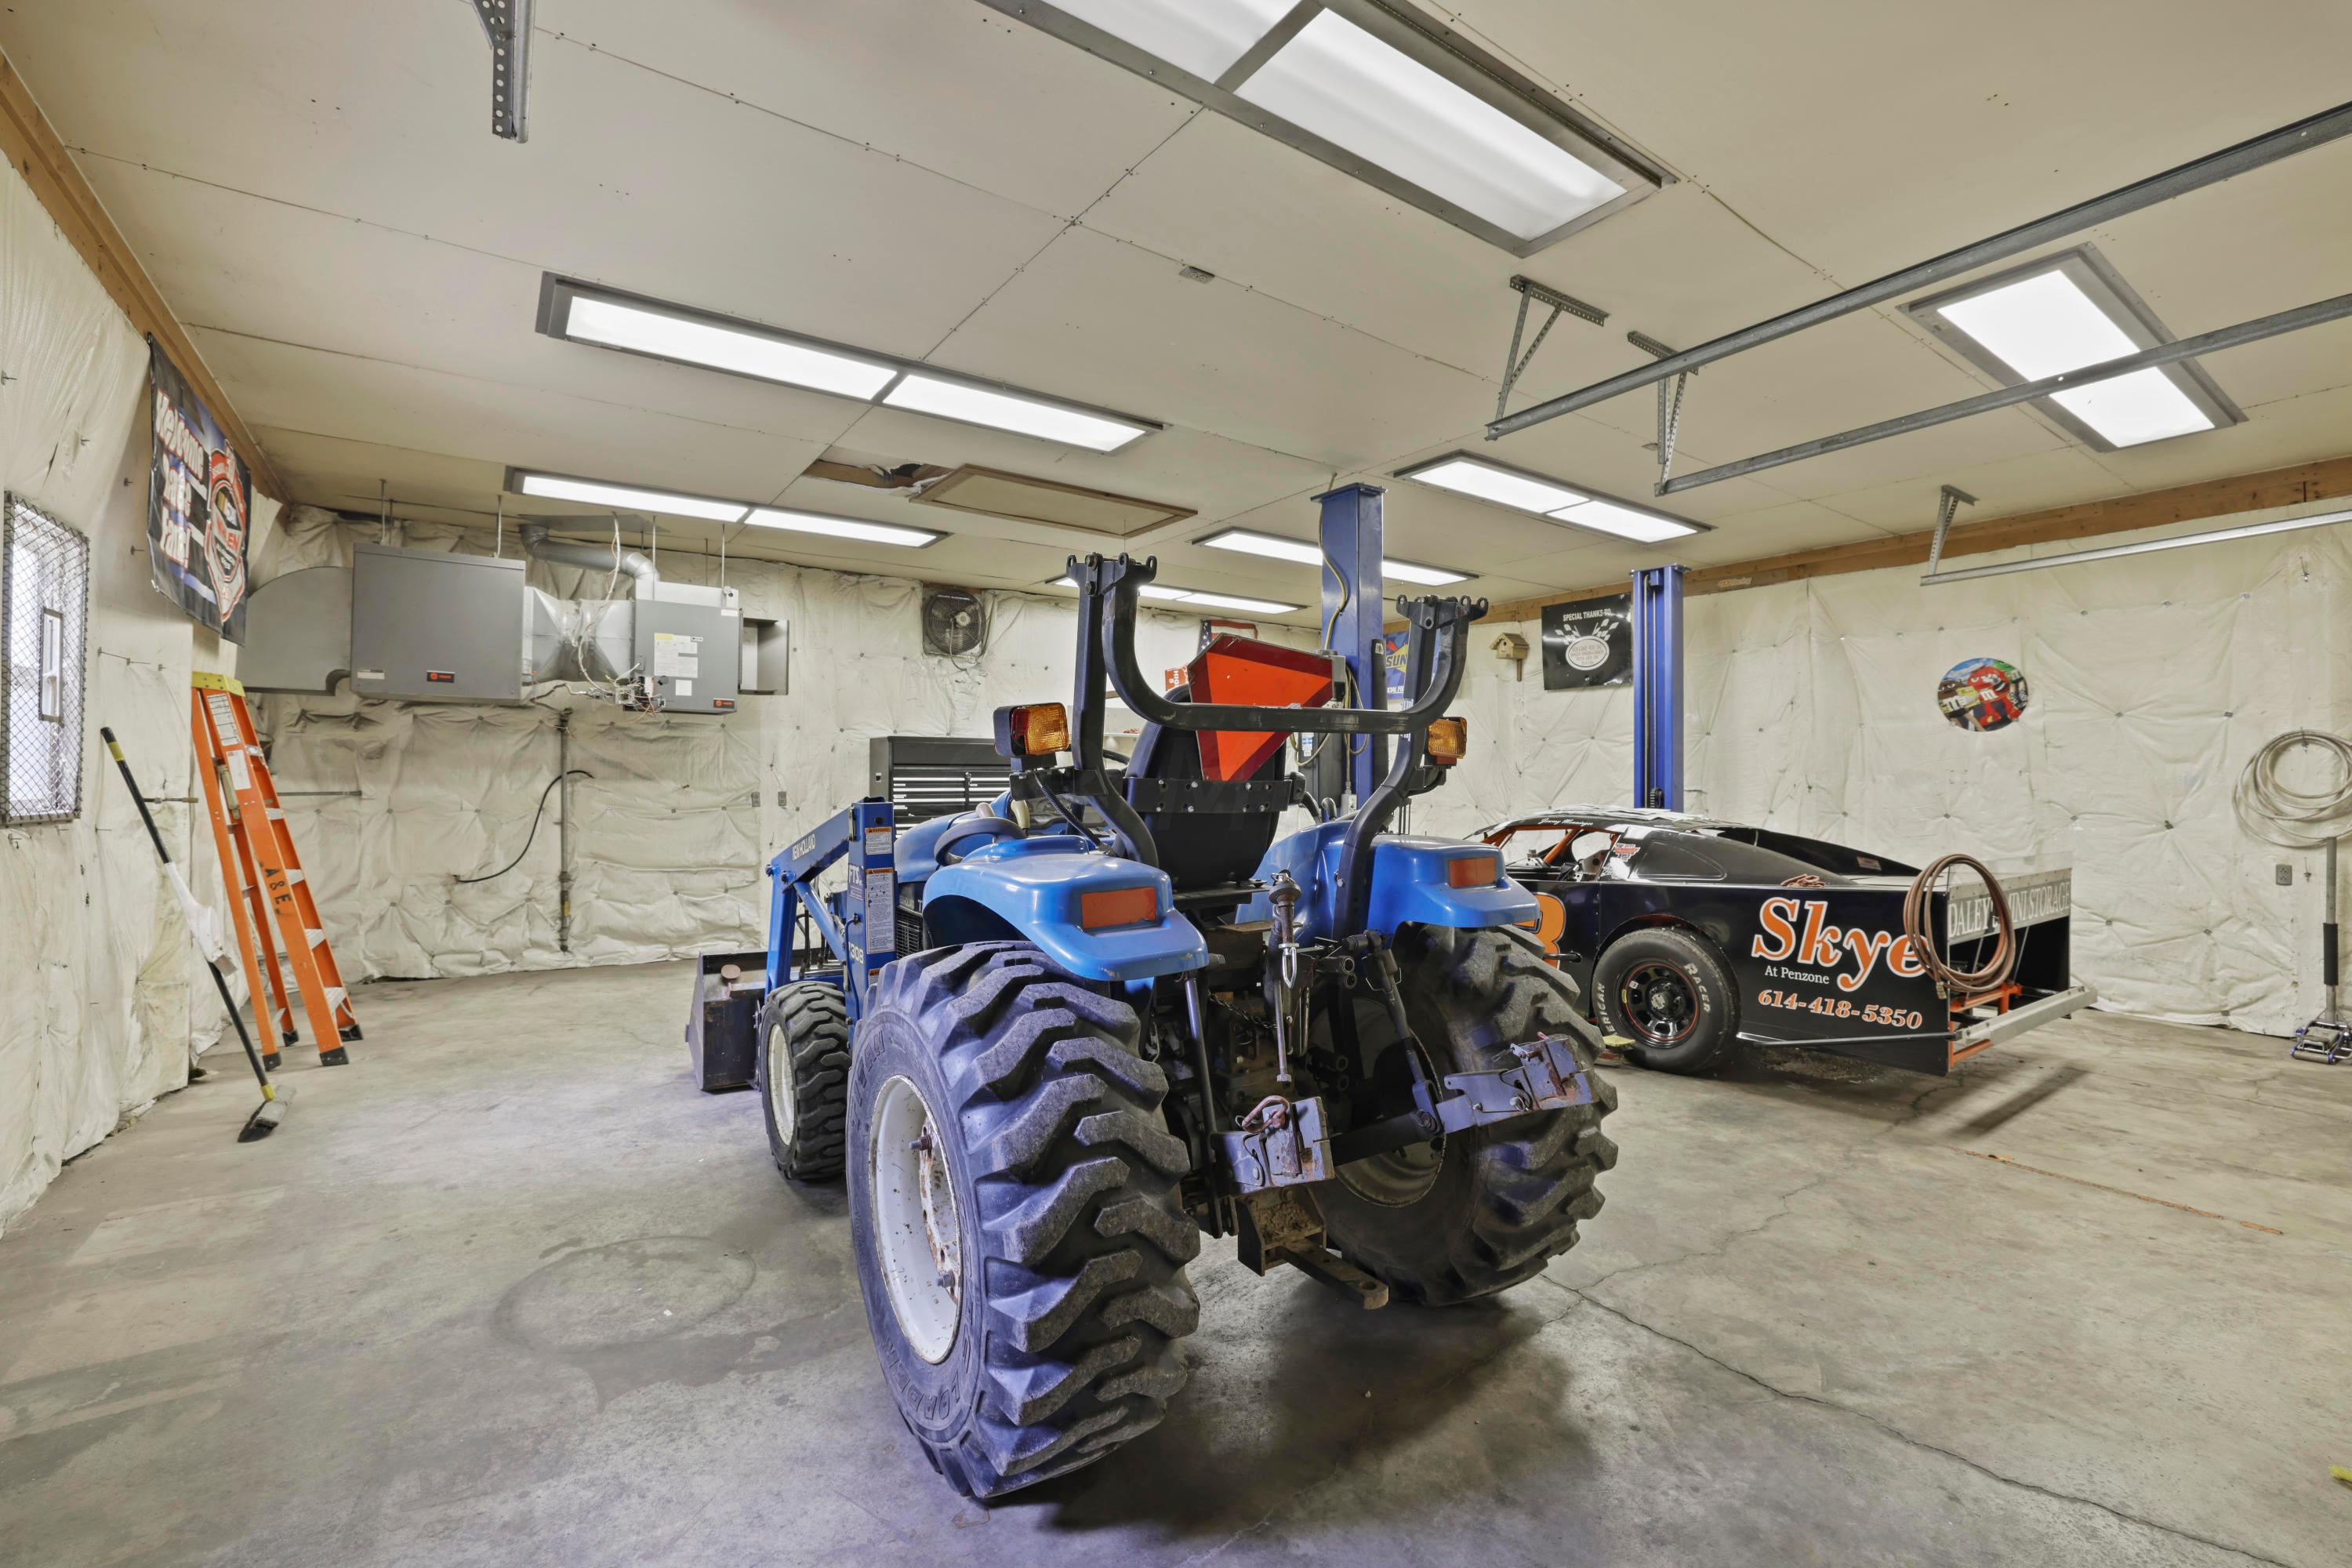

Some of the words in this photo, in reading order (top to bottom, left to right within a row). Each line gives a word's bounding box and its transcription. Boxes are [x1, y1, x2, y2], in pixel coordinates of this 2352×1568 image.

[1563, 612, 1583, 622] SPECIAL
[1583, 609, 1603, 619] THANKS
[1603, 608, 1612, 616] TO
[1386, 653, 1408, 667] SUN
[2028, 881, 2071, 920] STORAGE
[848, 942, 864, 964] 308
[1751, 896, 1929, 992] Skye
[1765, 965, 1779, 978] At
[1780, 967, 1830, 984] Penzone
[1597, 982, 1617, 1033] ERICAN
[1684, 962, 1711, 1014] RACER
[1758, 989, 1923, 1030] 614-418-5350
